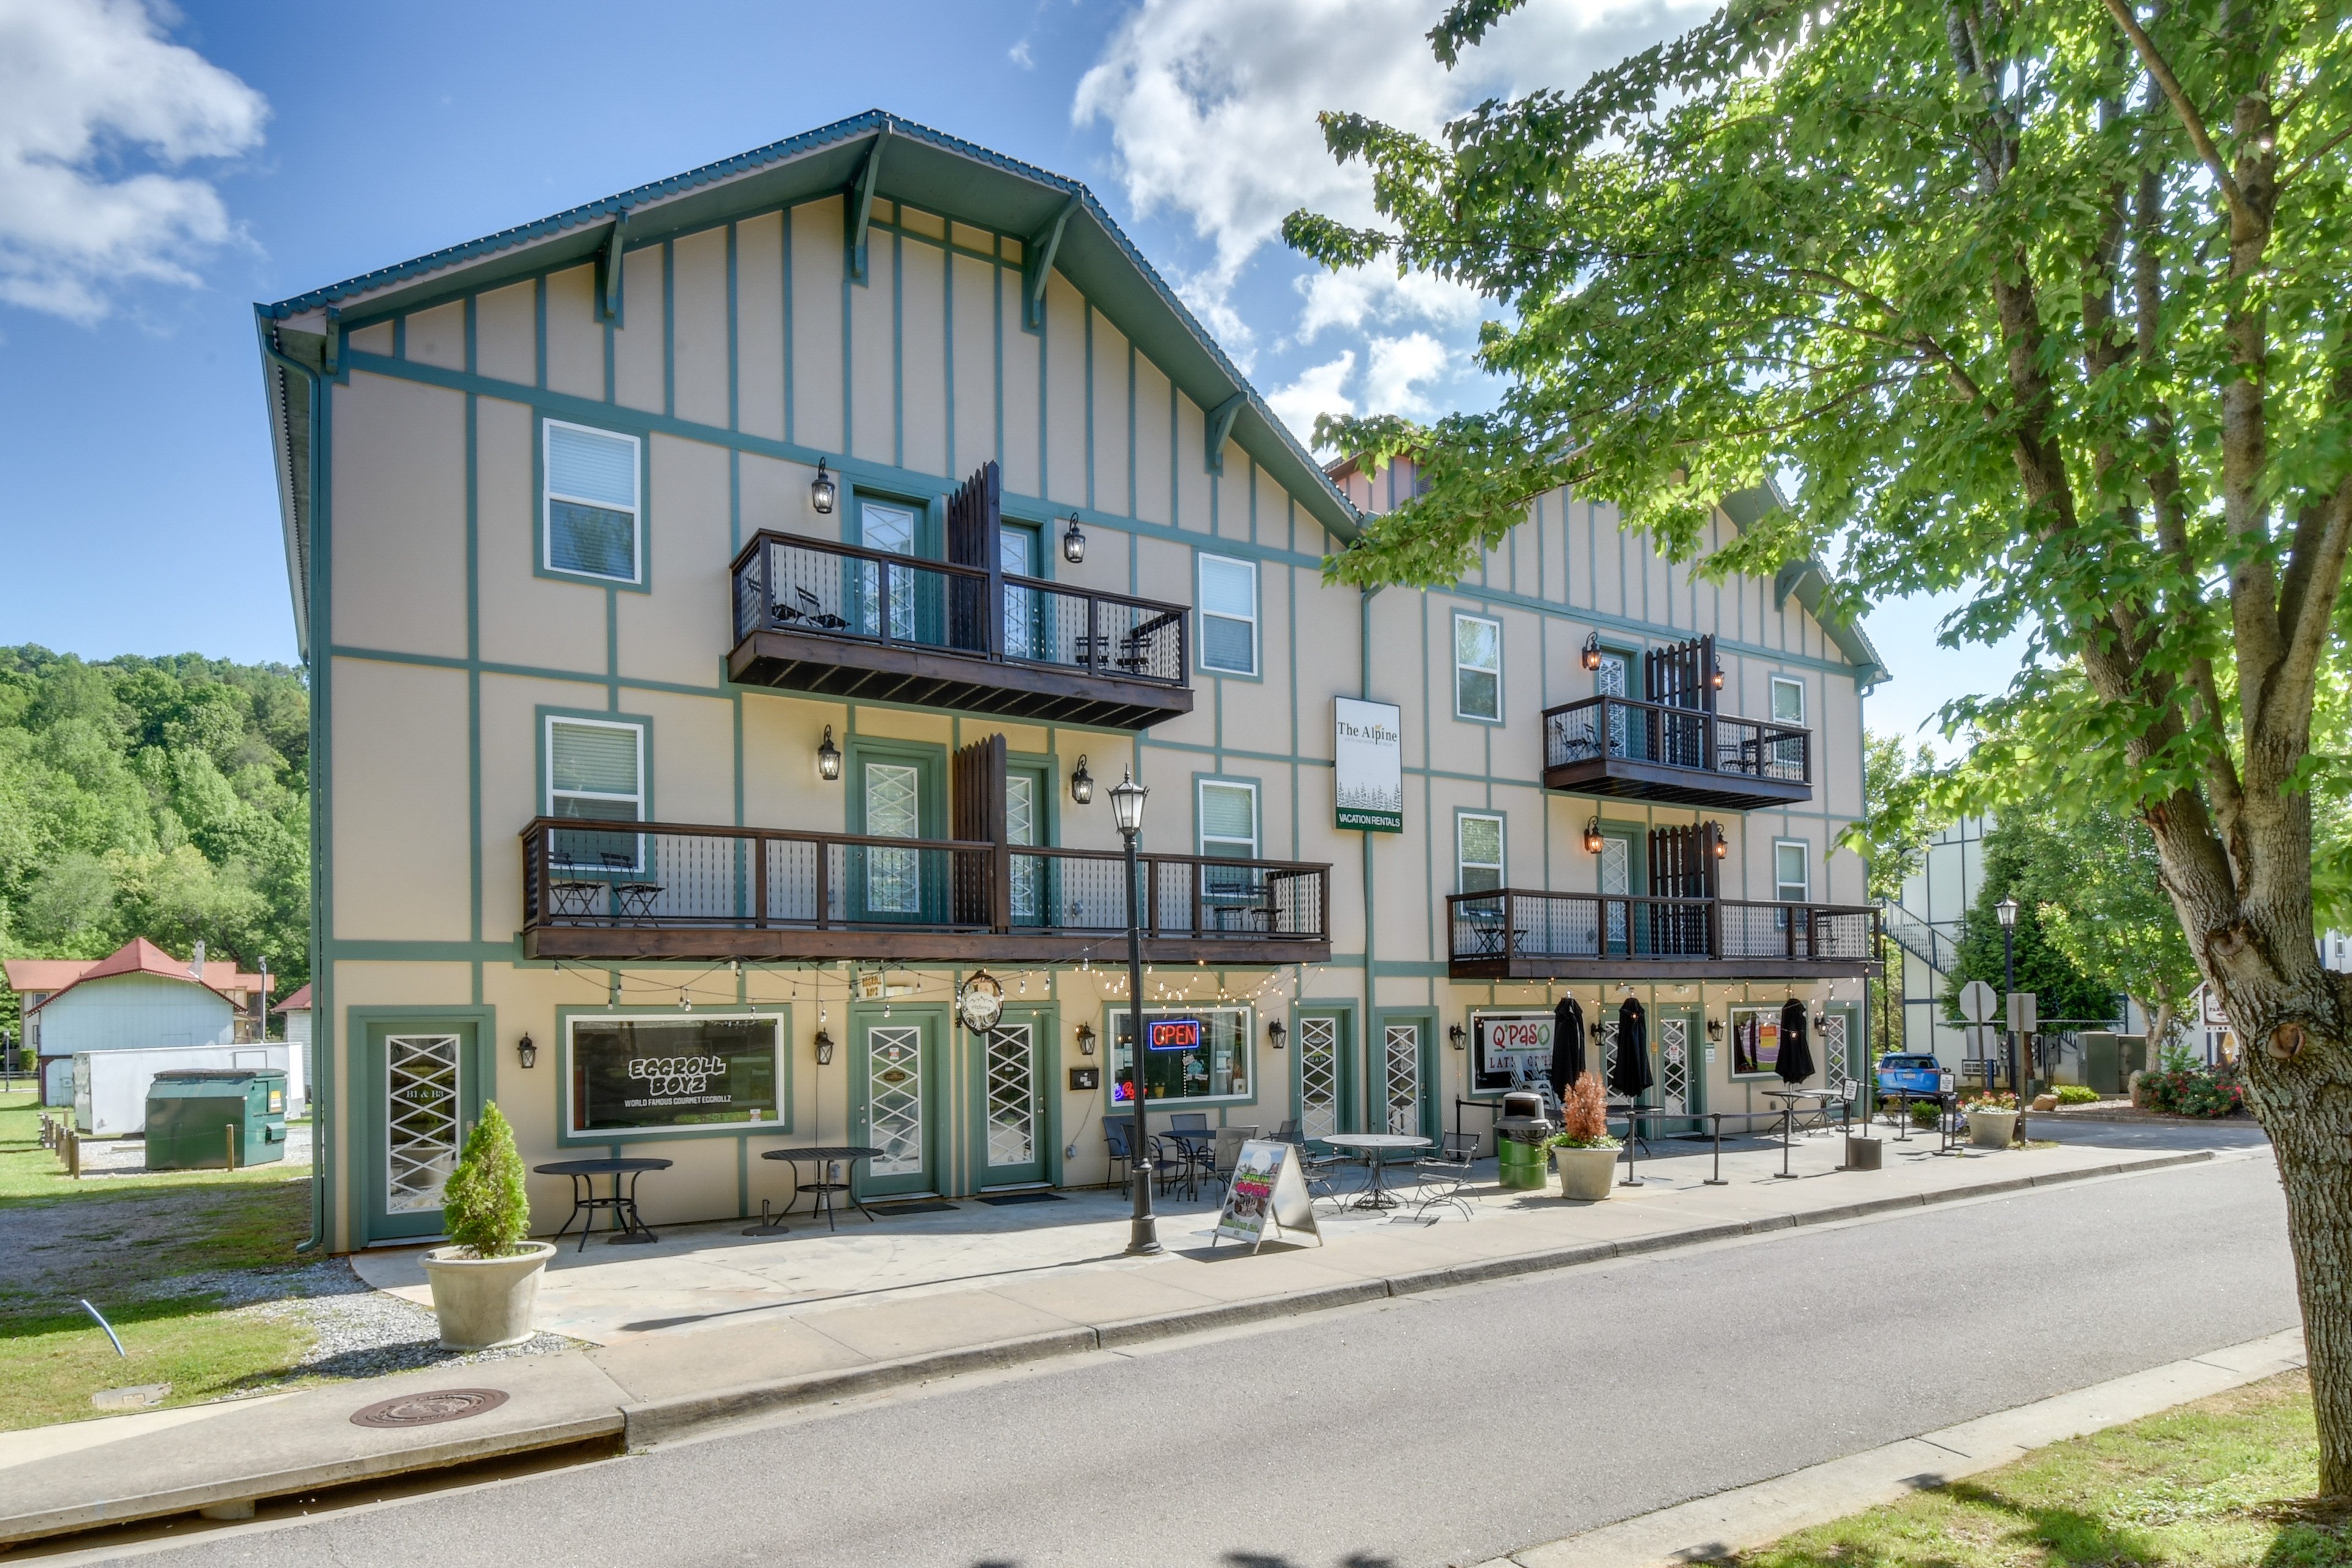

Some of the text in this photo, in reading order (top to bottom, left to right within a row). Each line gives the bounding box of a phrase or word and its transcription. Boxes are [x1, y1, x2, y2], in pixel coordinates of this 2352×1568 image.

[1338, 722, 1397, 745] The Alpine
[1338, 813, 1401, 827] VACATION RENTALS
[1153, 1025, 1196, 1046] OPEN
[628, 1055, 726, 1080] EGGROLL
[420, 1090, 428, 1098] &
[650, 1075, 707, 1096] BOYZ
[648, 1098, 673, 1107] FAMOUS
[673, 1096, 701, 1105] GOURMET
[702, 1095, 731, 1104] EGGROLLZ
[1236, 1182, 1271, 1197] OPEN
